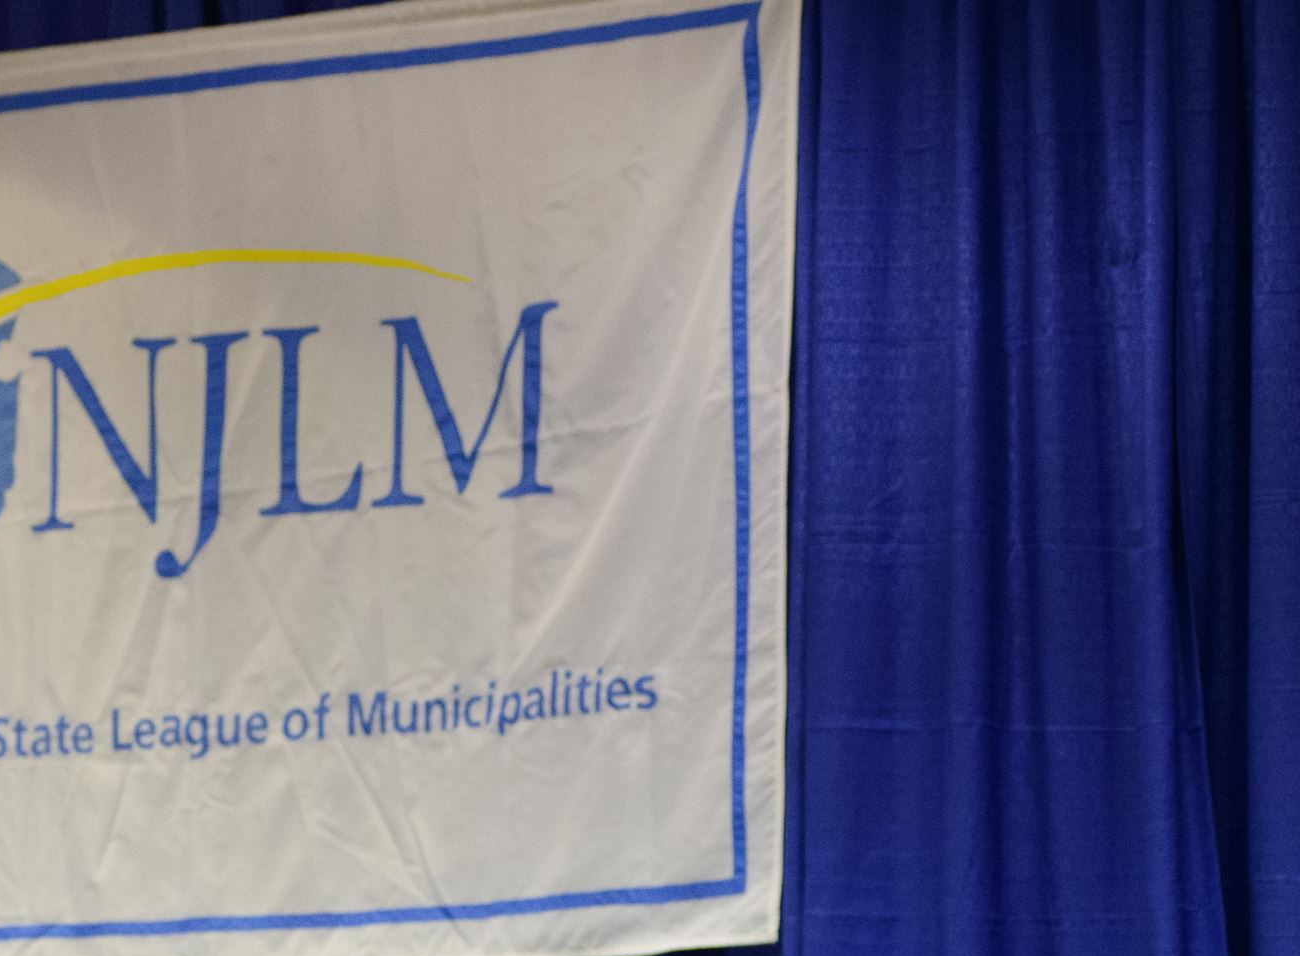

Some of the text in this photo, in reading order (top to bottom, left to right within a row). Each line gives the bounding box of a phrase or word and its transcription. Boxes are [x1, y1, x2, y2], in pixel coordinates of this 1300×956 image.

[31, 300, 558, 578] NJLM
[112, 708, 268, 759] League
[282, 692, 330, 740] of
[347, 668, 659, 736] Municipalities
